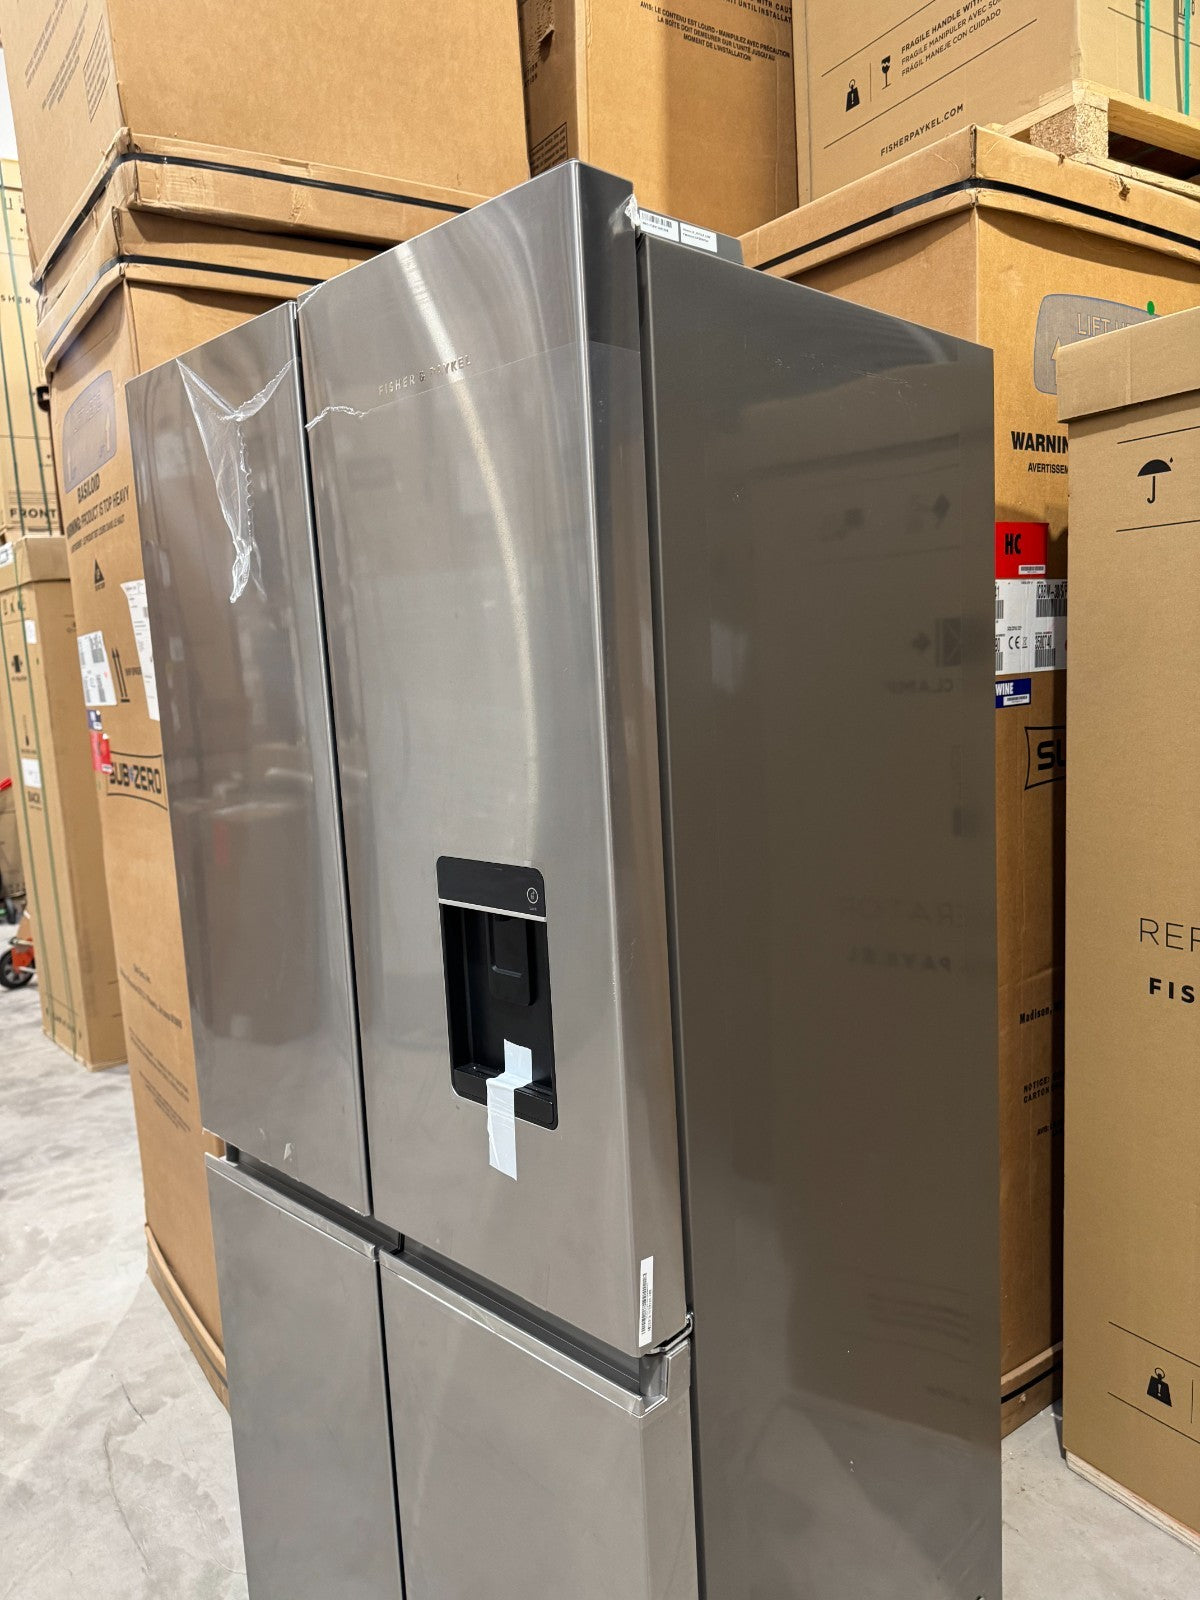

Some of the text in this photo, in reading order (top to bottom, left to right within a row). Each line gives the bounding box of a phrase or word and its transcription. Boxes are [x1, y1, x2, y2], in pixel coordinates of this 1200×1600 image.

[654, 6, 661, 14] LE
[662, 8, 687, 23] CONTENU
[687, 18, 697, 27] EST
[657, 16, 664, 24] LA
[683, 33, 705, 46] MOMENT
[706, 41, 713, 49] DE
[901, 30, 931, 54] FRAGILE
[931, 9, 961, 34] HANDLE
[901, 43, 928, 65] FRAGILE
[929, 18, 967, 48] MANIPULER
[968, 5, 986, 22] AVEC
[925, 40, 952, 62] MANEJE
[952, 29, 968, 44] CON
[969, 8, 1001, 33] CUIDADO
[880, 103, 964, 156] FISHERPAYKEL.COM
[1077, 313, 1111, 337] LIFT
[378, 374, 415, 396] FISHER
[1011, 431, 1068, 454] WARNIN
[112, 485, 129, 509] HEAVY
[10, 507, 56, 519] FRONT
[1005, 533, 1021, 555] HC
[995, 682, 1014, 696] WINE
[1149, 977, 1195, 1003] FIS
